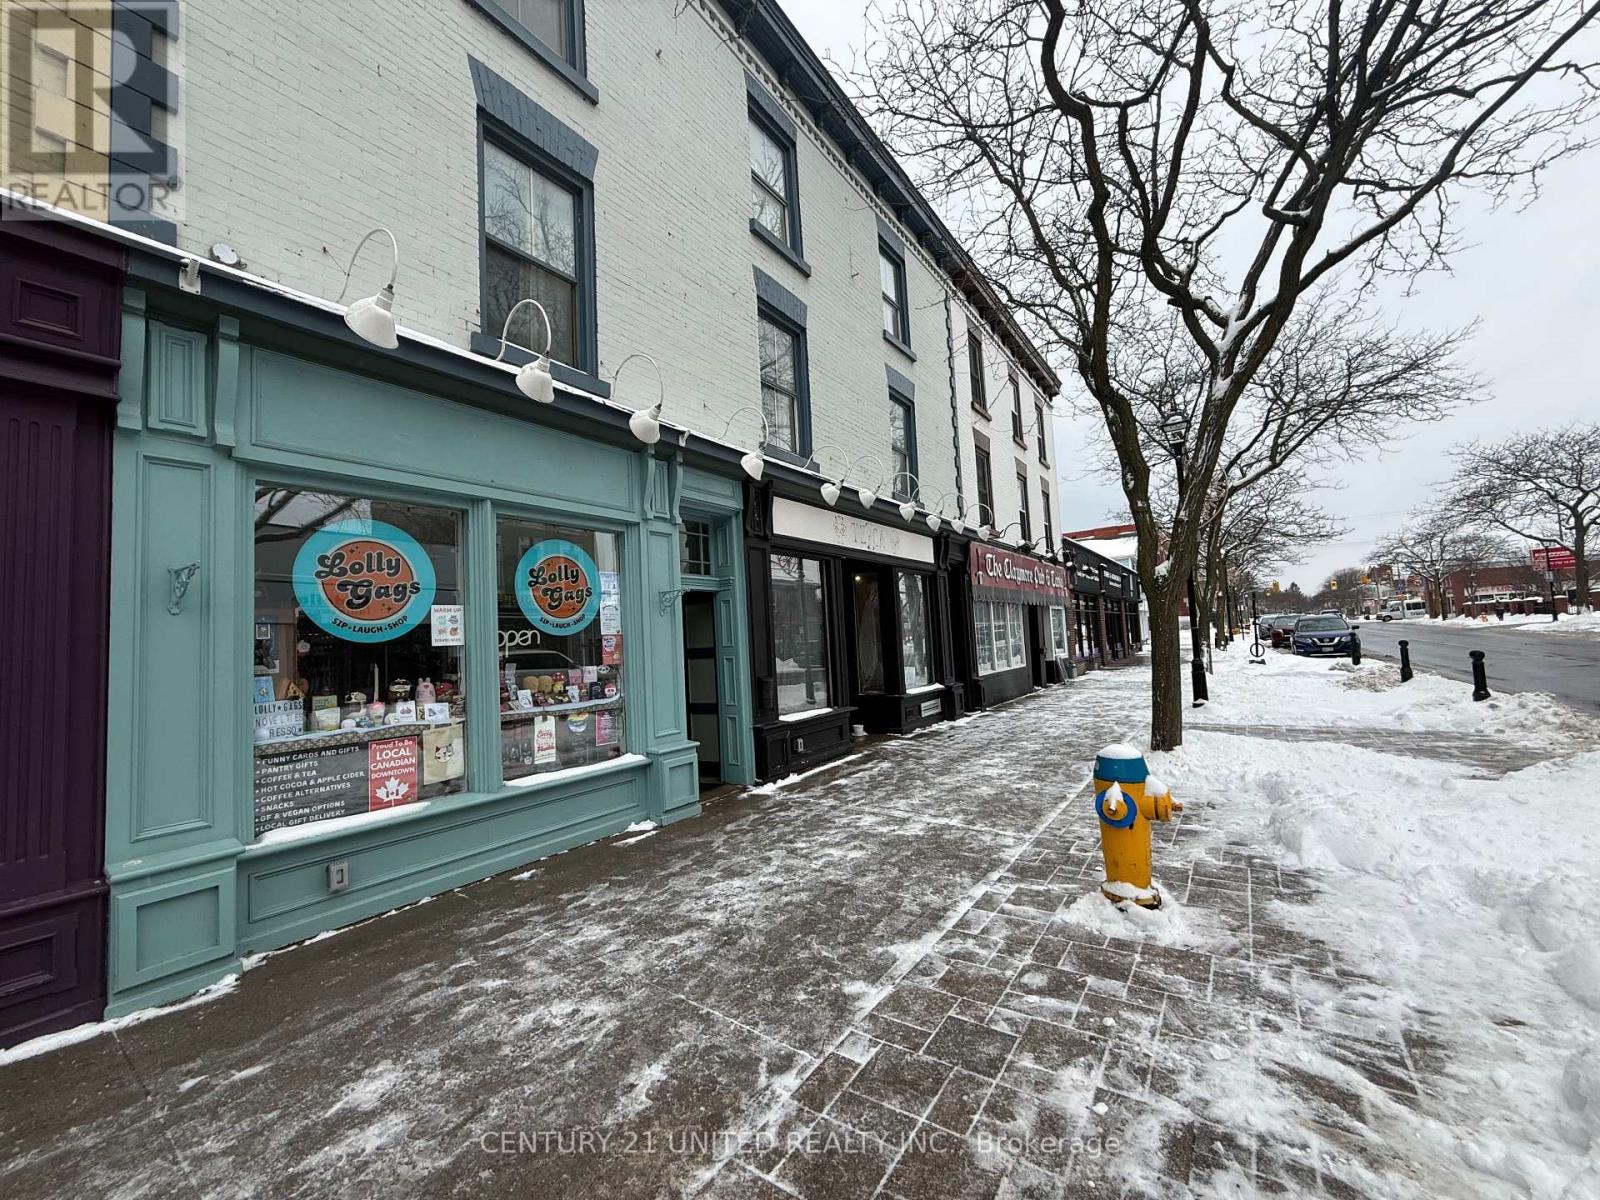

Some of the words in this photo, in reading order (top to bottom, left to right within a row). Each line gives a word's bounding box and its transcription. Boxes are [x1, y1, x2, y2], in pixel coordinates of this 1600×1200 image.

[314, 550, 401, 580] Lolly
[985, 553, 1003, 578] The
[527, 563, 580, 588] Lolly
[336, 577, 421, 610] Gags
[540, 586, 593, 611] Gags
[331, 617, 348, 629] SIP
[352, 624, 384, 634] LAUGH
[388, 615, 409, 631] SHOP
[254, 703, 277, 715] LOLLY
[283, 701, 303, 712] GAGS
[262, 755, 292, 765] FUNNY
[292, 751, 319, 761] CARDS
[320, 748, 337, 757] AND
[338, 745, 360, 754] GIFTS
[371, 742, 394, 750] Proud
[376, 747, 412, 760] LOCAL
[261, 764, 294, 775] PANTRY
[295, 760, 319, 770] GIFTS
[371, 757, 416, 771] CANADIAN
[371, 767, 415, 779] DOWNTOWN
[261, 774, 292, 784] COFFEE
[302, 769, 317, 777] TEA
[261, 785, 278, 794] HOT
[279, 779, 308, 790] COCOA
[316, 775, 341, 784] APPLE
[342, 771, 366, 780] CIDER
[261, 792, 293, 803] COFFEE
[294, 782, 352, 798] ALTERNATIVES
[260, 801, 295, 813] SNACKS
[260, 814, 272, 822] GF
[282, 807, 310, 818] VEGAN
[311, 801, 346, 813] OPTIONS
[260, 822, 287, 832] LOCAL
[288, 816, 306, 826] GIFT
[309, 809, 346, 821] DELIVERY
